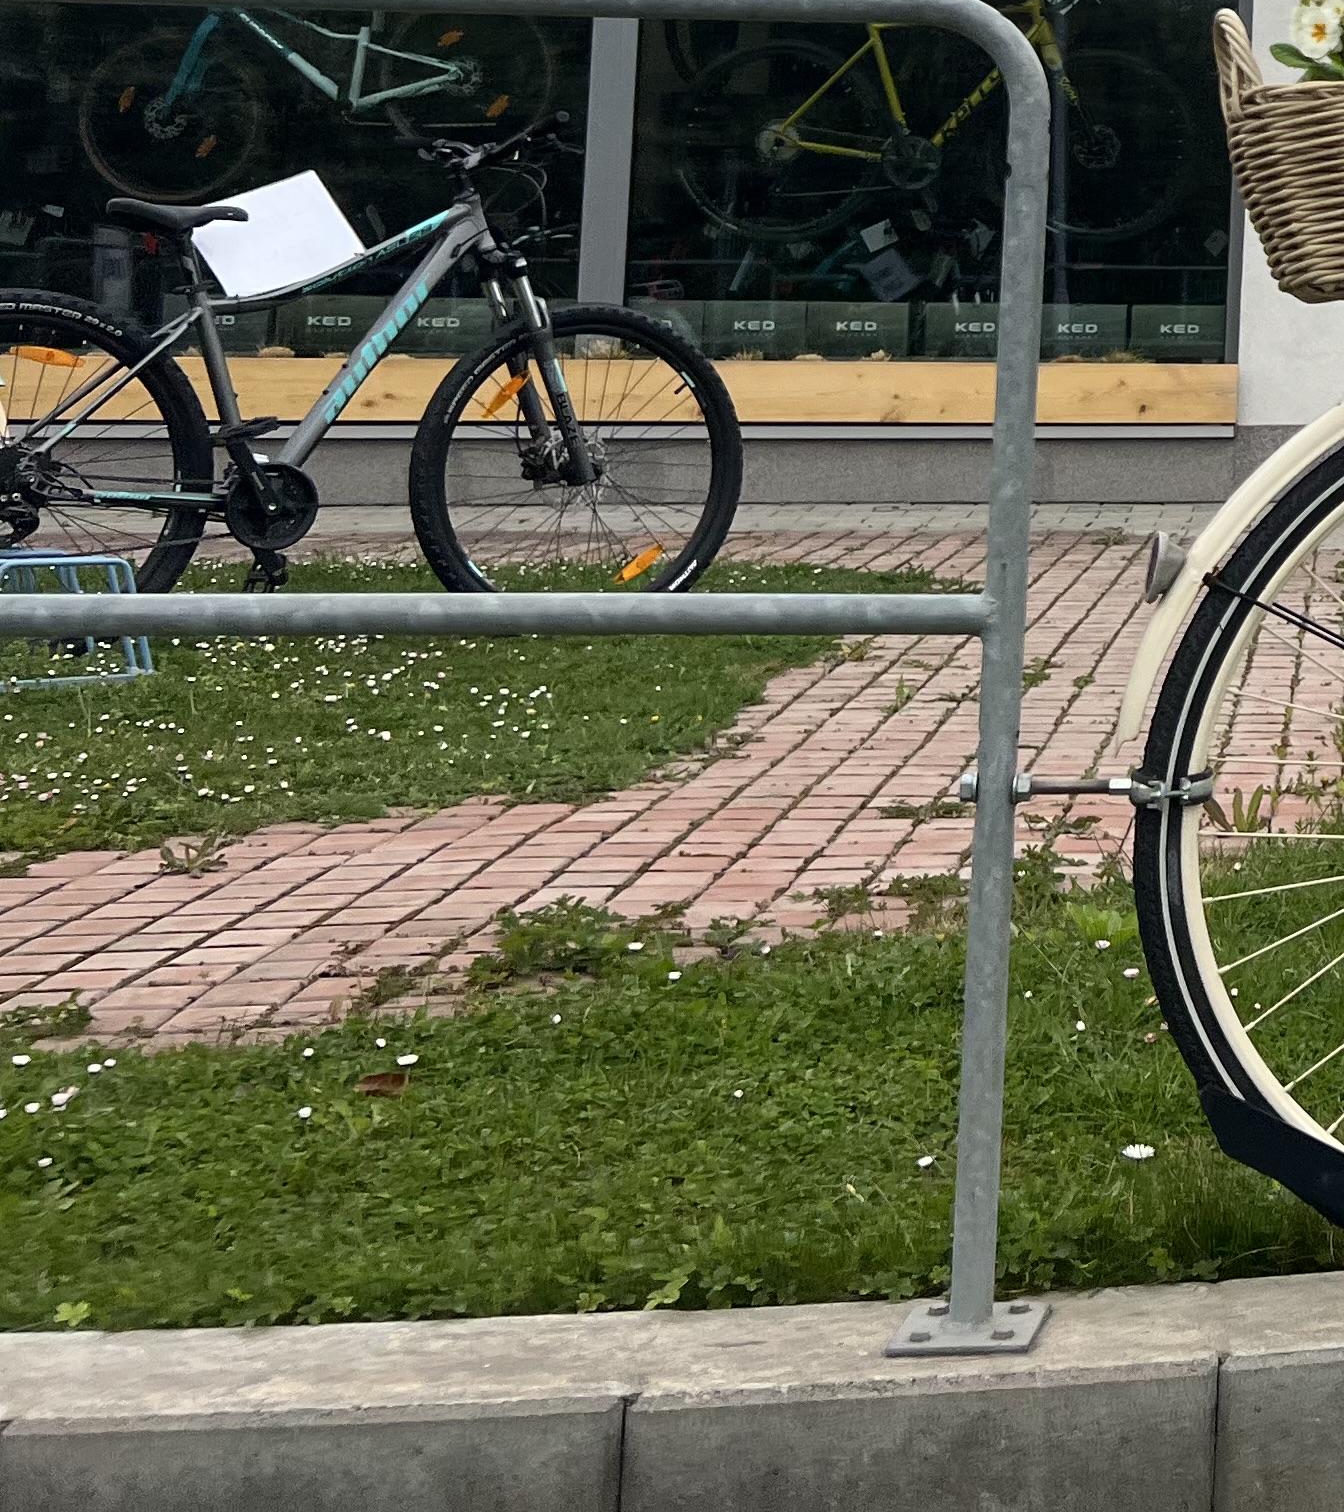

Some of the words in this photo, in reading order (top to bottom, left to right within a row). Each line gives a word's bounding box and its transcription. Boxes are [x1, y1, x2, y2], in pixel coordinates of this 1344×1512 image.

[307, 316, 351, 326] KED
[417, 317, 460, 327] KED
[734, 320, 775, 331] KED
[836, 321, 877, 331] KED
[955, 322, 996, 332] KED
[1057, 323, 1098, 333] KED
[1160, 324, 1200, 334] KED
[556, 392, 580, 446] BLAZE
